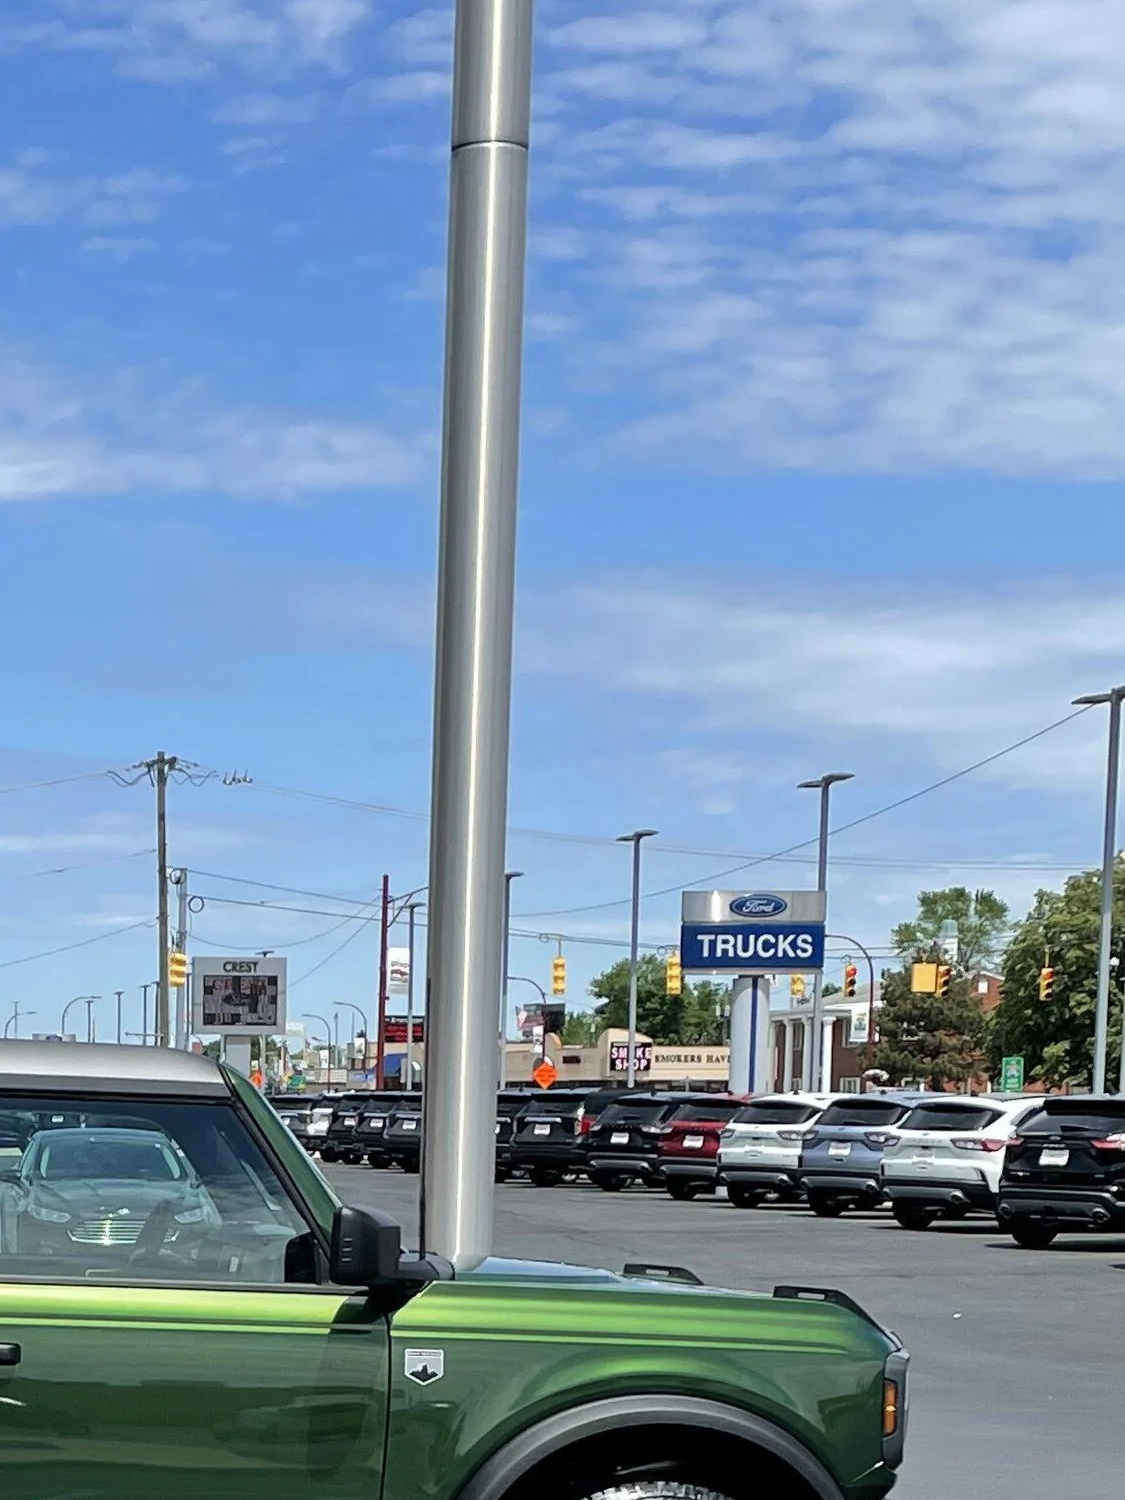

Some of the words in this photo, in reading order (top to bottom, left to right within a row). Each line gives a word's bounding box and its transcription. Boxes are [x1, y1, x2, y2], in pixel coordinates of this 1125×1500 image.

[741, 898, 776, 913] Ford
[696, 933, 814, 958] TRUCKS
[222, 960, 259, 973] CREST
[611, 1046, 652, 1059] SMKE
[654, 1054, 703, 1064] SMOKERS
